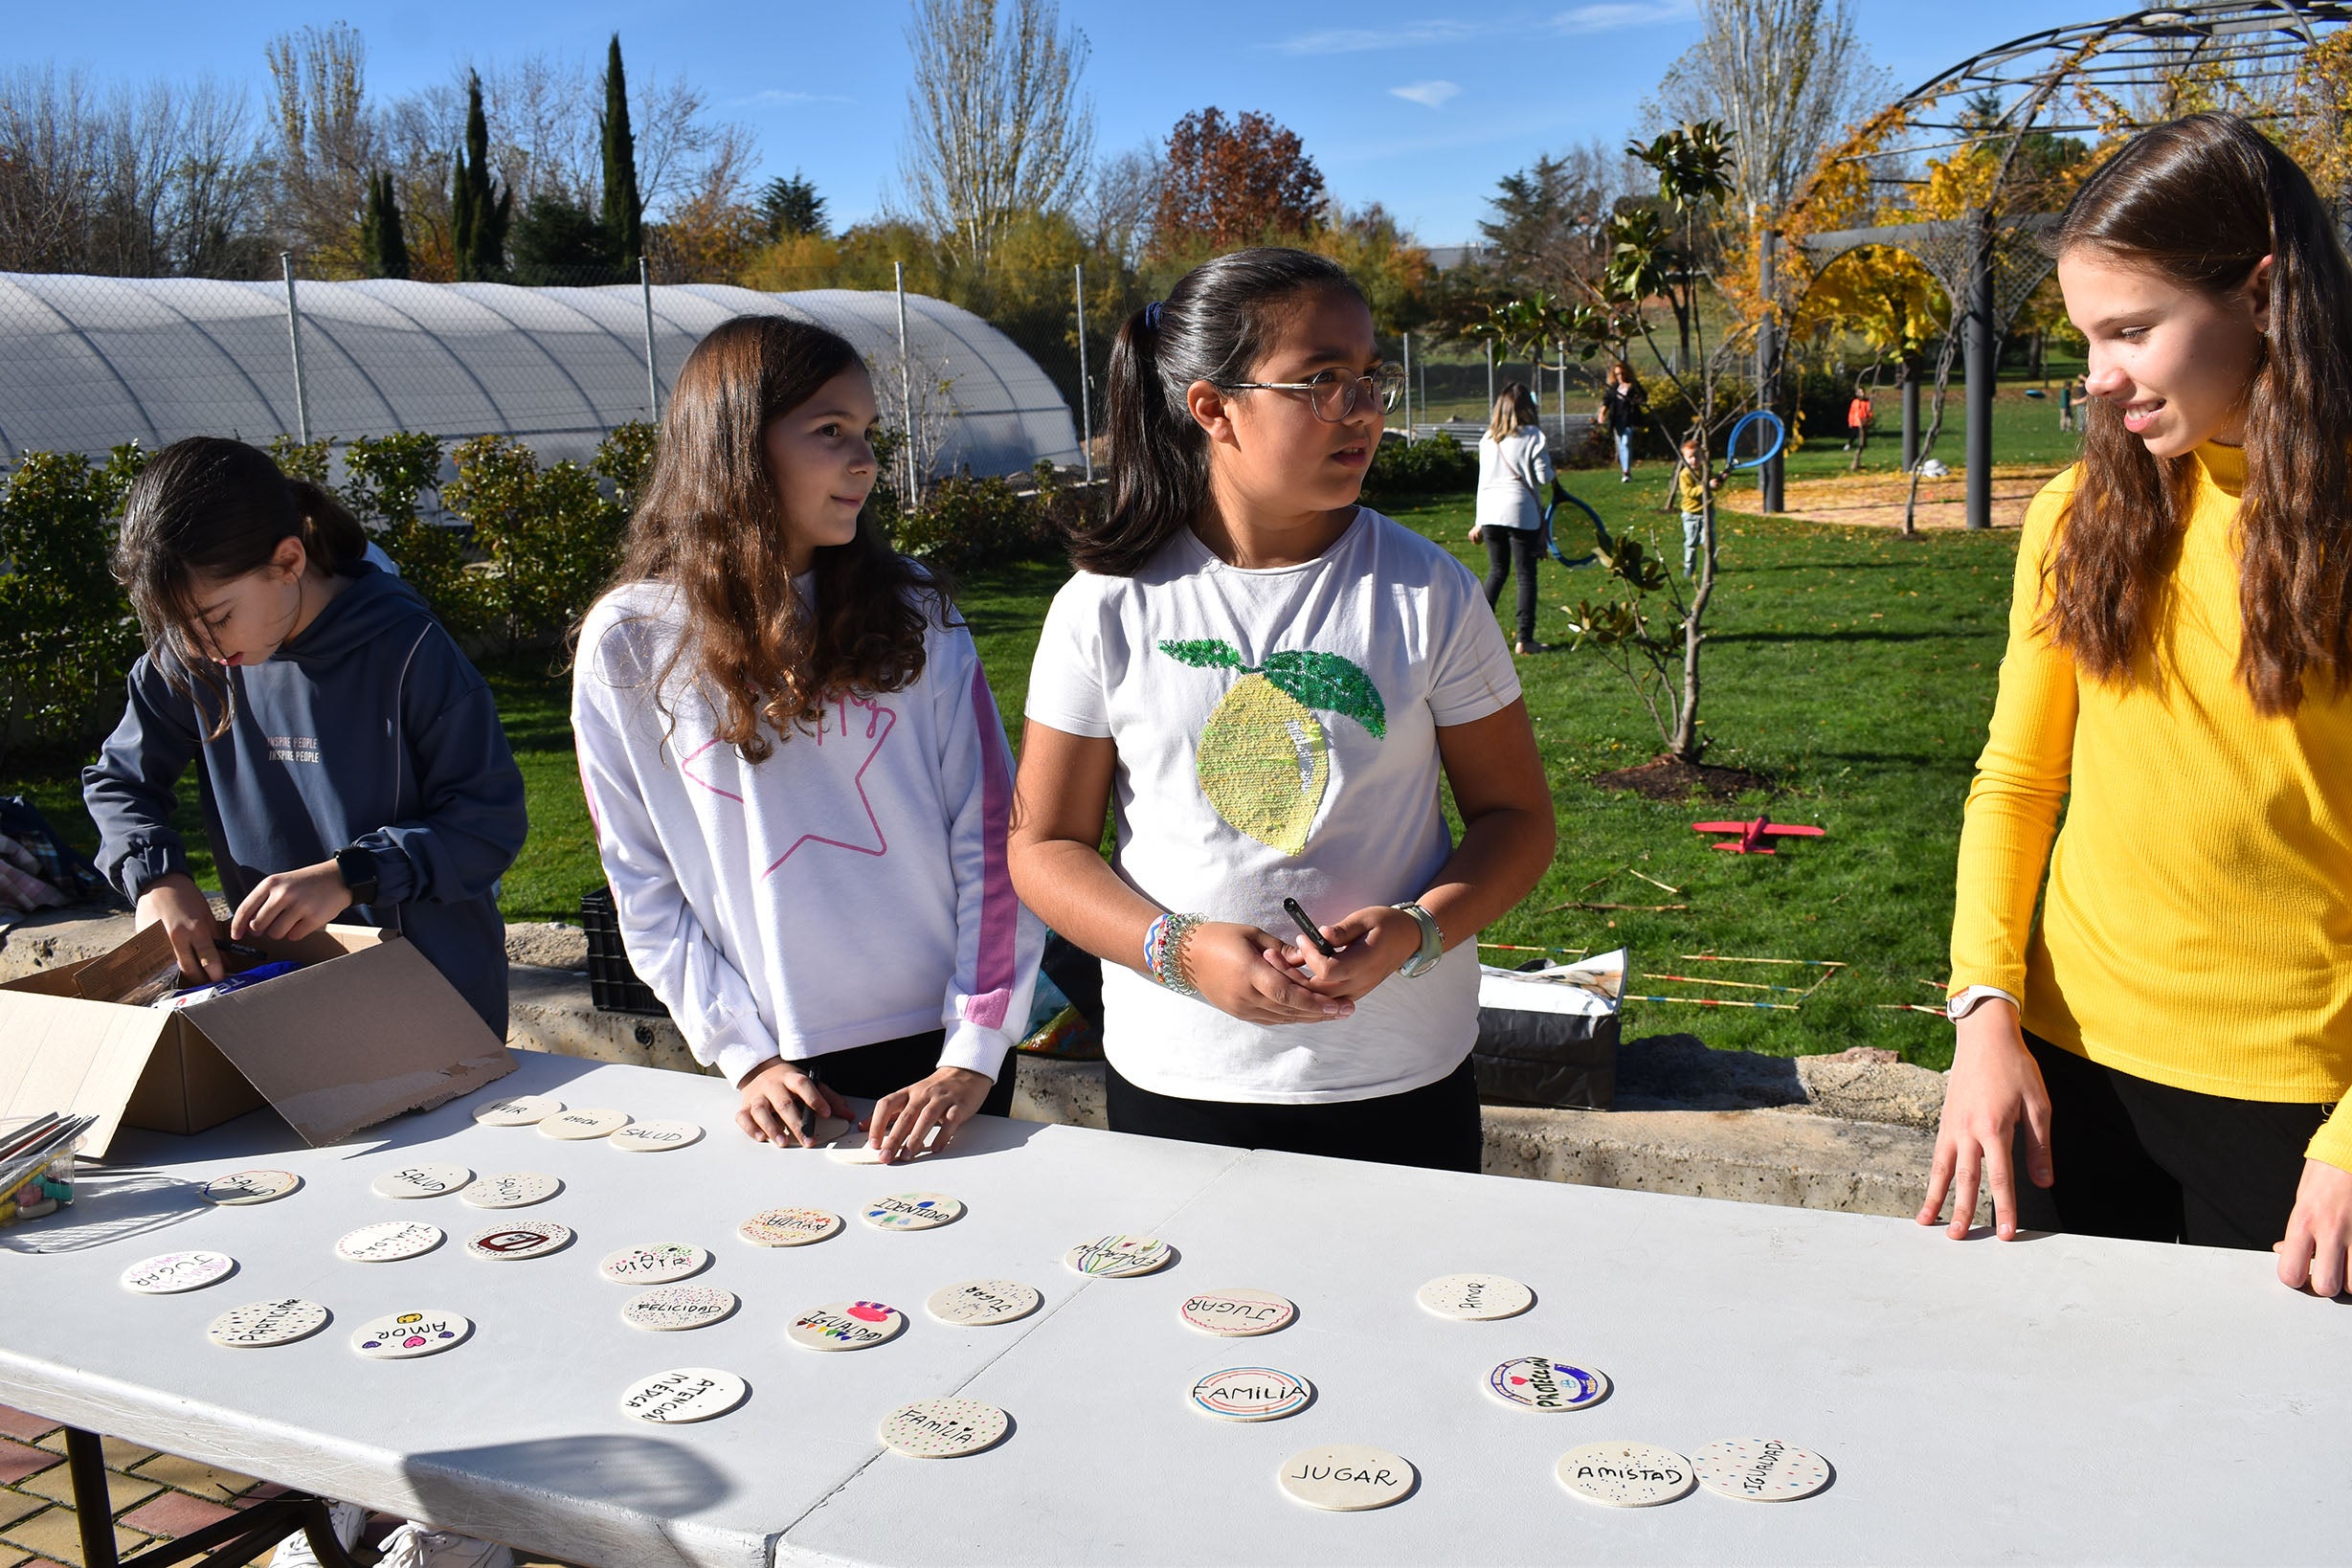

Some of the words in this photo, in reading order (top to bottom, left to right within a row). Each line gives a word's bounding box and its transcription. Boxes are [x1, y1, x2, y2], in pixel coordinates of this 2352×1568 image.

[267, 736, 291, 748] INSPIRE
[293, 736, 319, 750] PEOPLE
[268, 750, 294, 762] INSPIRE
[295, 750, 320, 764] PEOPLE
[490, 1101, 528, 1115] VIVIR
[619, 1128, 683, 1142] SALUD
[223, 1175, 277, 1197] SALUD
[394, 1168, 446, 1192] SALUD
[496, 1176, 522, 1201] SALUD
[873, 1198, 951, 1222] IDENTIDAD
[766, 1214, 827, 1232] AYUDA
[129, 1254, 214, 1287] JUGAR
[637, 1303, 722, 1315] FELICIDAD
[965, 1286, 1013, 1313] JUGAR
[1186, 1298, 1277, 1321] JUGAR
[237, 1298, 302, 1341] PARTICIPAR
[375, 1320, 447, 1340] AMOR
[640, 1378, 716, 1422] ATENCIÓN
[1290, 1464, 1399, 1487] JUGAR
[1577, 1466, 1684, 1486] AMISTAD
[1742, 1441, 1786, 1491] IGUALDAD
